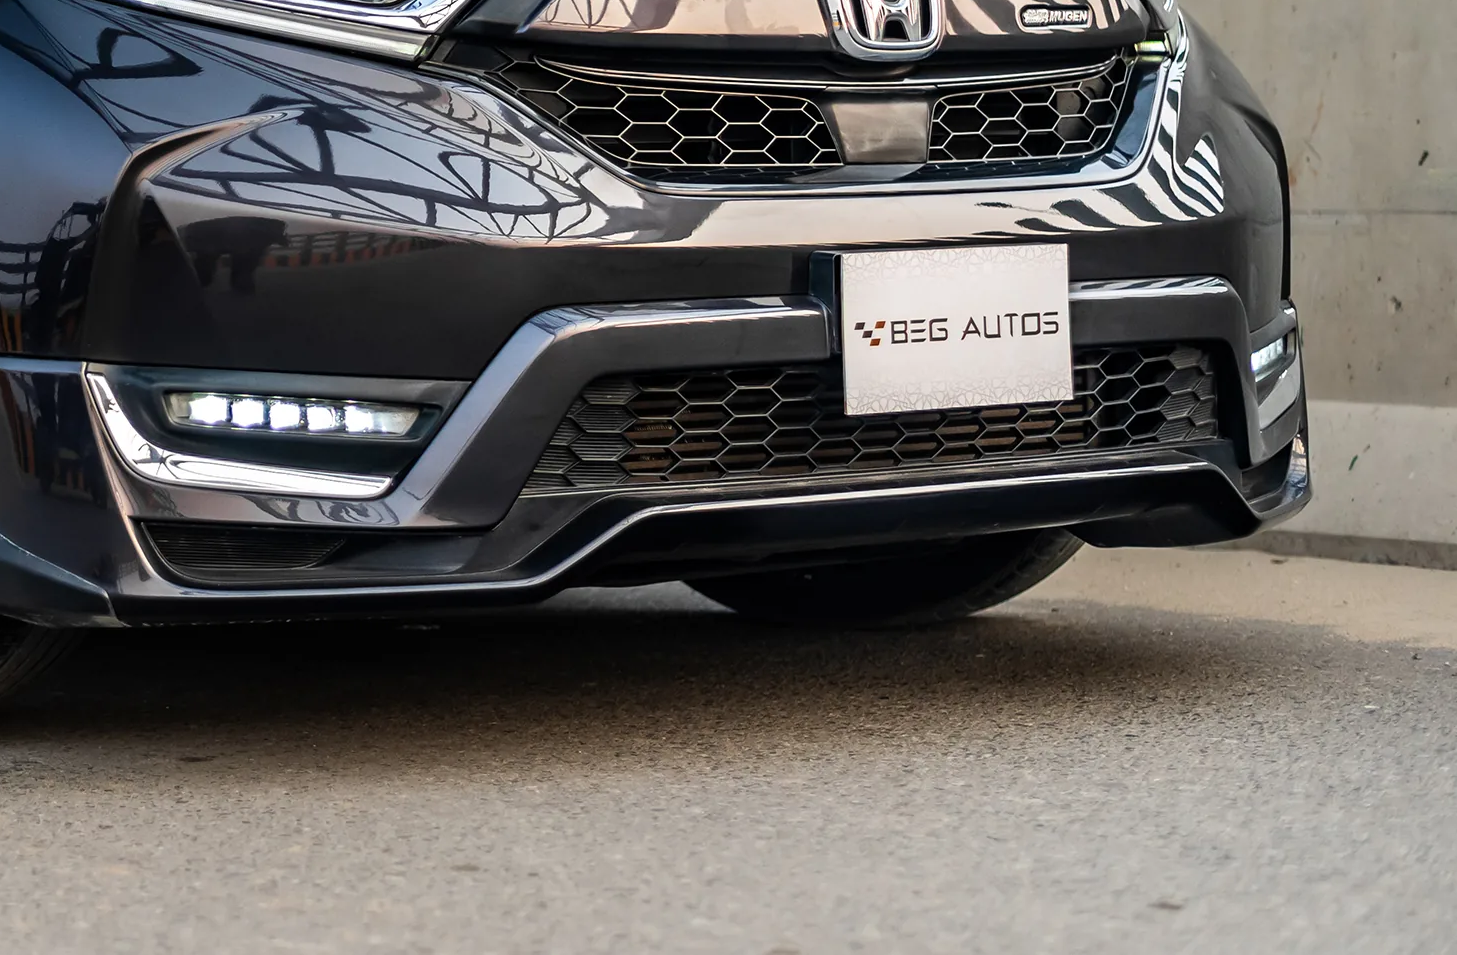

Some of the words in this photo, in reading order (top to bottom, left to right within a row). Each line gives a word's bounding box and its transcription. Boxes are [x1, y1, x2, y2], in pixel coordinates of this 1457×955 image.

[1049, 9, 1088, 23] MUGEN
[890, 317, 949, 345] BEG
[960, 311, 1060, 341] AUTOS
